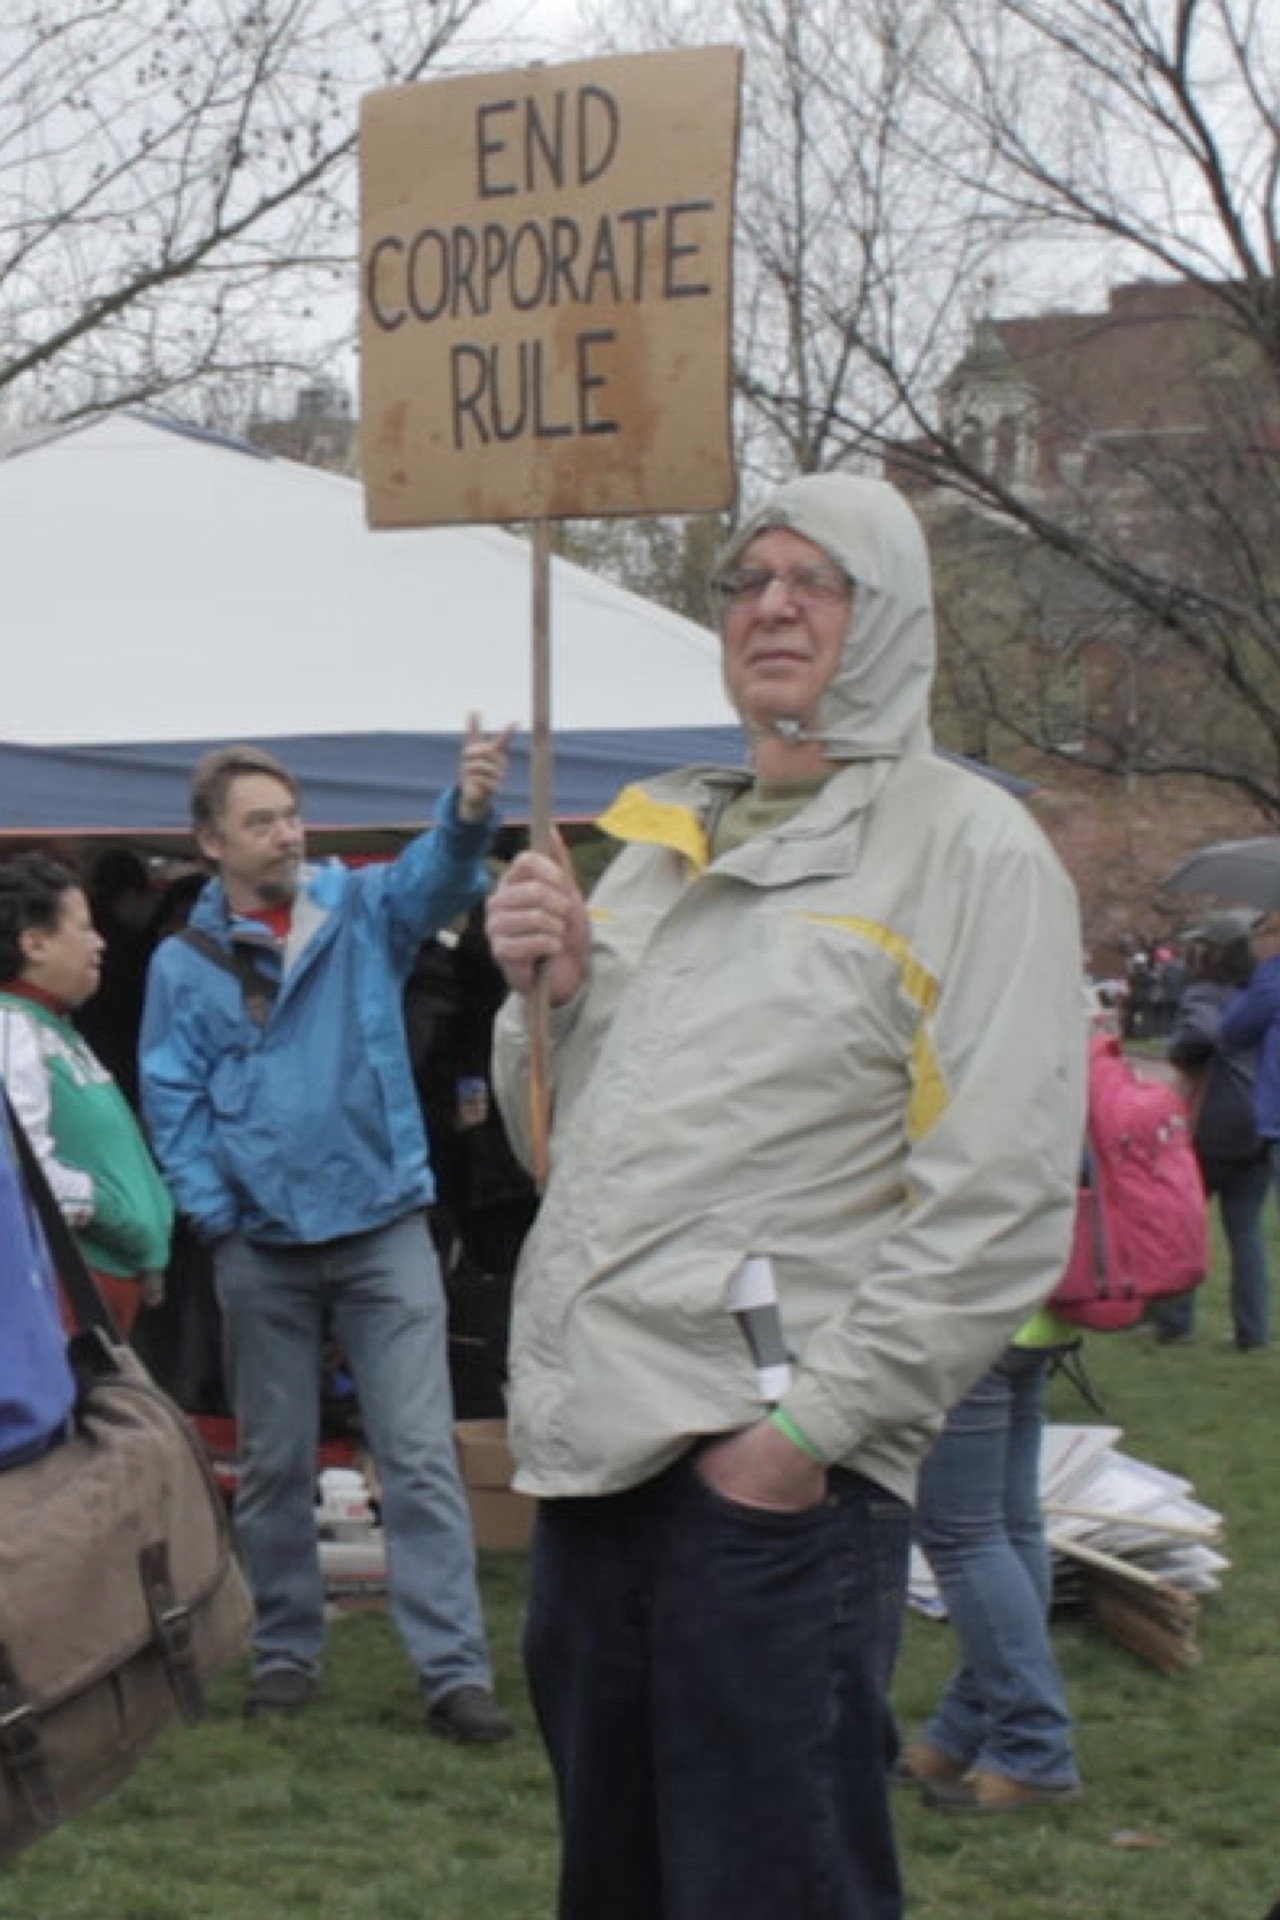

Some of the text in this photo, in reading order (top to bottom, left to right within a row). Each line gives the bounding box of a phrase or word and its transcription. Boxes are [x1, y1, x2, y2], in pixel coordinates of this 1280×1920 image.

[477, 85, 619, 197] END
[368, 202, 713, 331] CORPORATE
[451, 331, 620, 449] RULE
